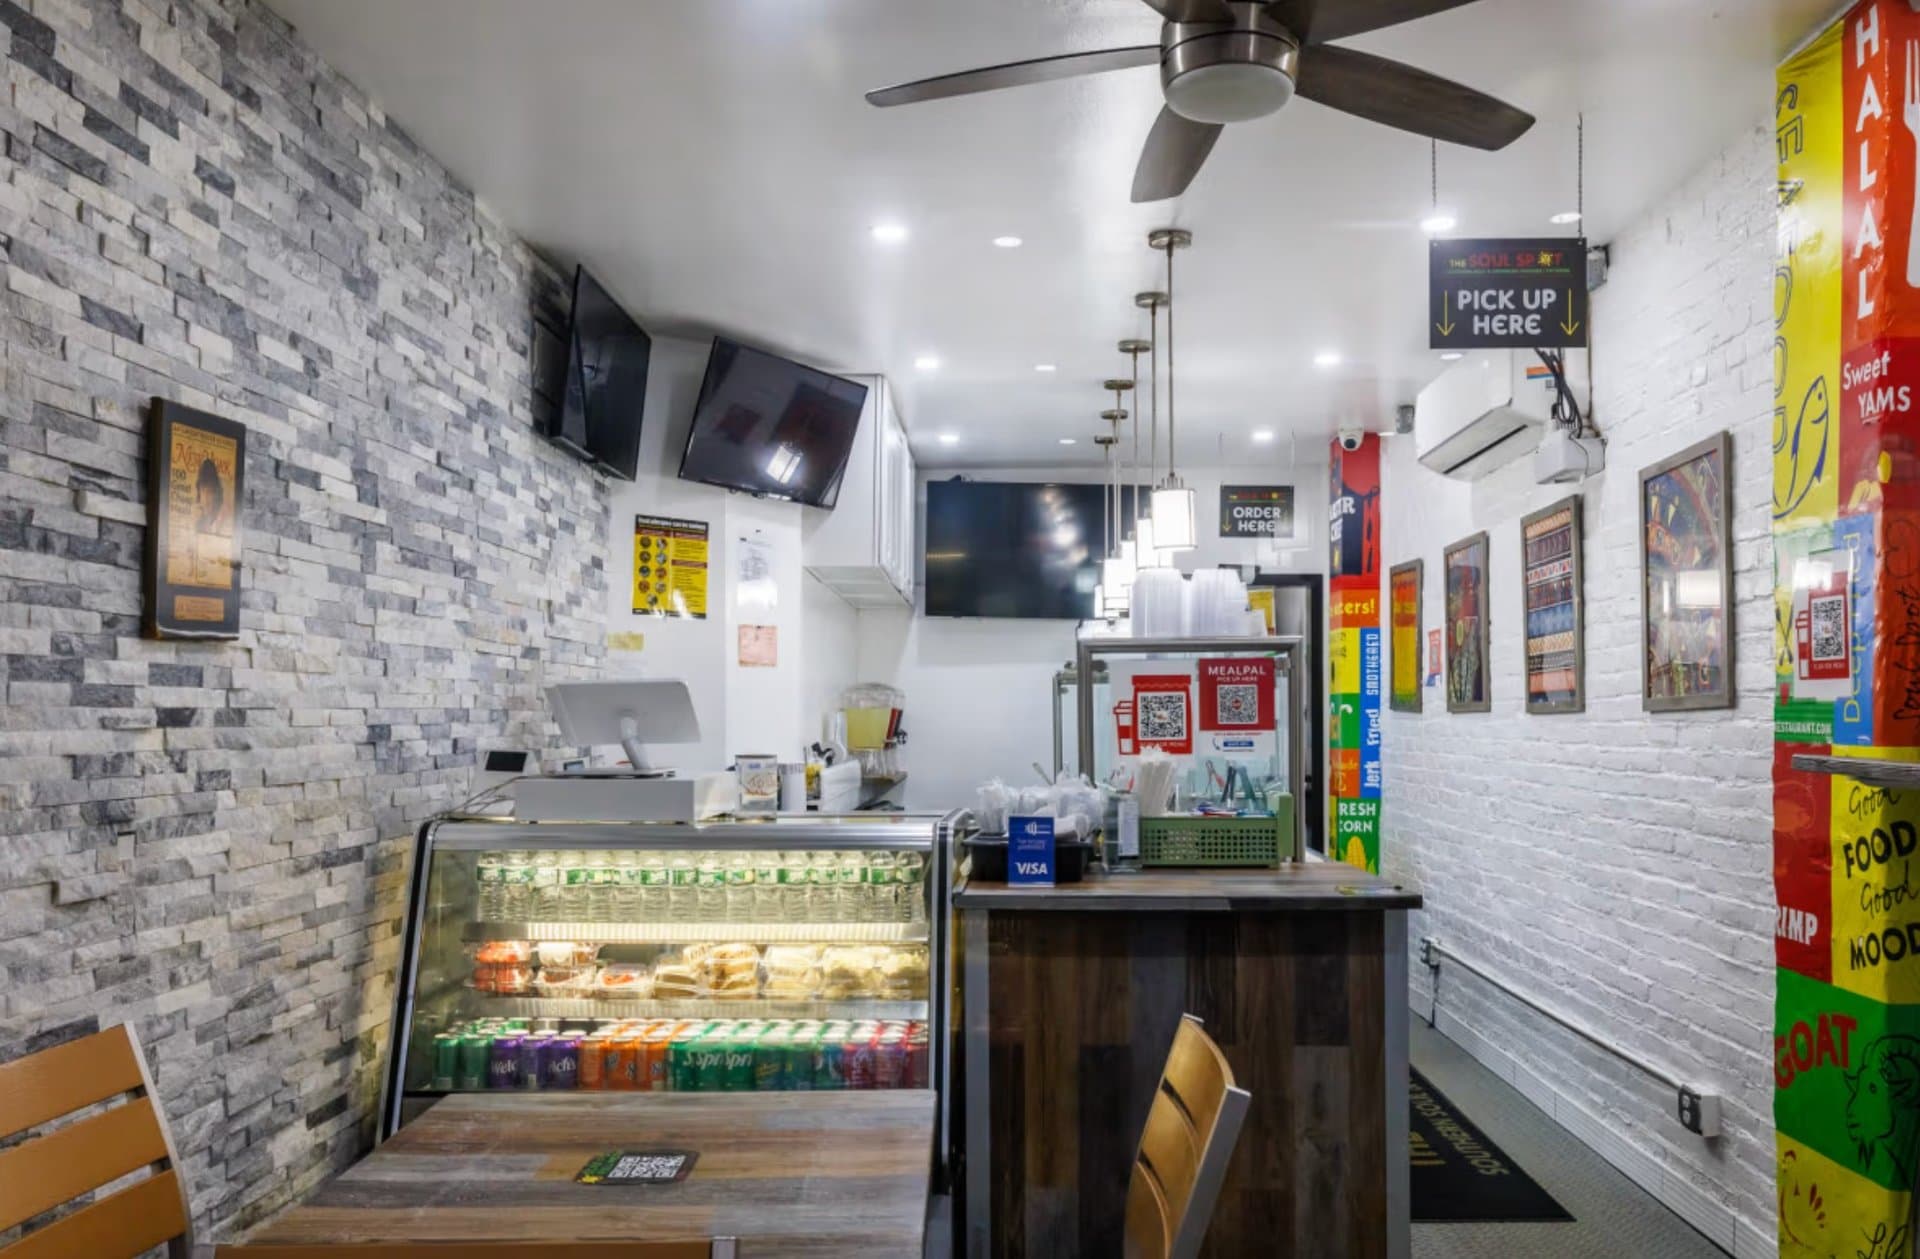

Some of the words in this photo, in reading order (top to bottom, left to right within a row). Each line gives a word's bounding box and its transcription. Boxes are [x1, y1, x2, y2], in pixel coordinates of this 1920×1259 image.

[1853, 3, 1883, 320] HALAL
[1469, 252, 1510, 267] SOUL
[1457, 289, 1515, 311] PICK
[1523, 289, 1556, 310] UP
[1473, 315, 1541, 335] HERE
[1843, 351, 1891, 390] Sweet
[1858, 386, 1911, 419] YAMS
[1233, 506, 1281, 518] ORDER
[1238, 520, 1276, 532] HERE
[1208, 665, 1266, 676] MEALPAL
[1364, 761, 1379, 788] Jerk
[1843, 820, 1917, 878] FOOD
[1014, 862, 1048, 875] VISA
[1861, 861, 1920, 919] Good
[1850, 922, 1920, 971] MOOD
[1774, 1013, 1857, 1089] GOAT
